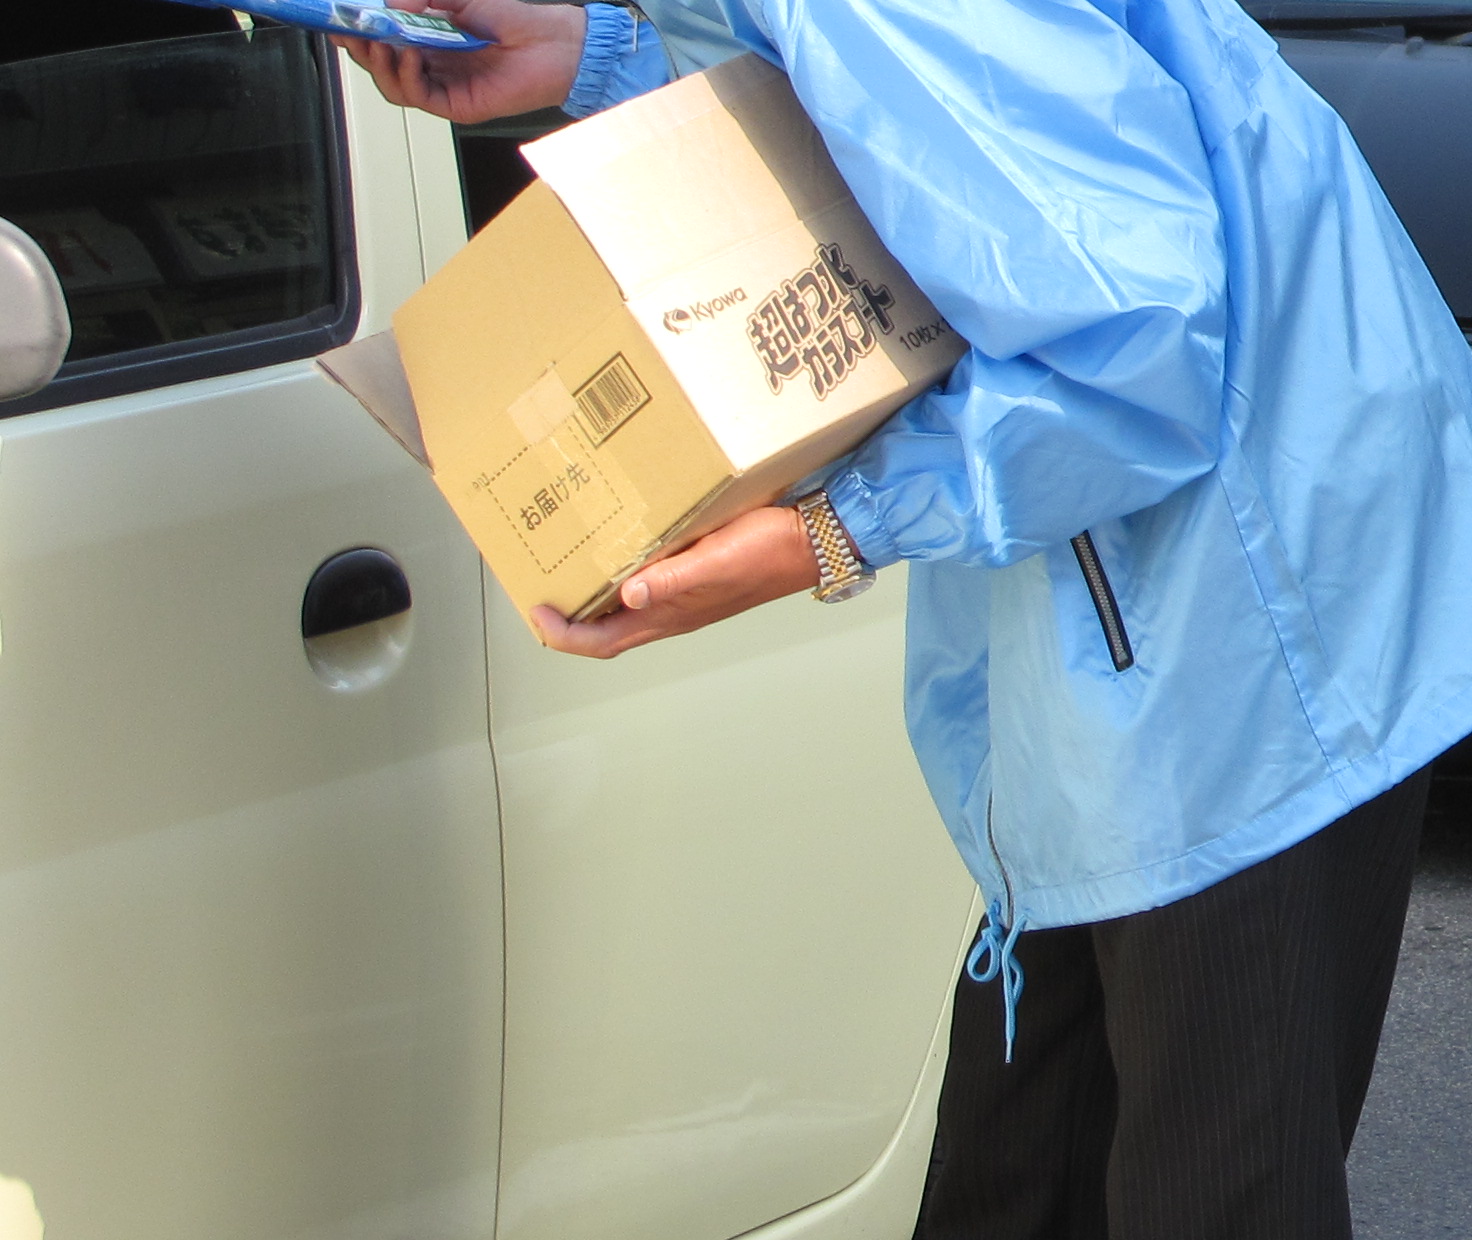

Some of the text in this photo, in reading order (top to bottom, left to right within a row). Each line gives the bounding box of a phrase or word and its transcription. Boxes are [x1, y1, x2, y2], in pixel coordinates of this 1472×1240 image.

[690, 286, 748, 322] Kyowa
[801, 279, 895, 401] ガラスコート
[519, 462, 591, 531] お届け先
